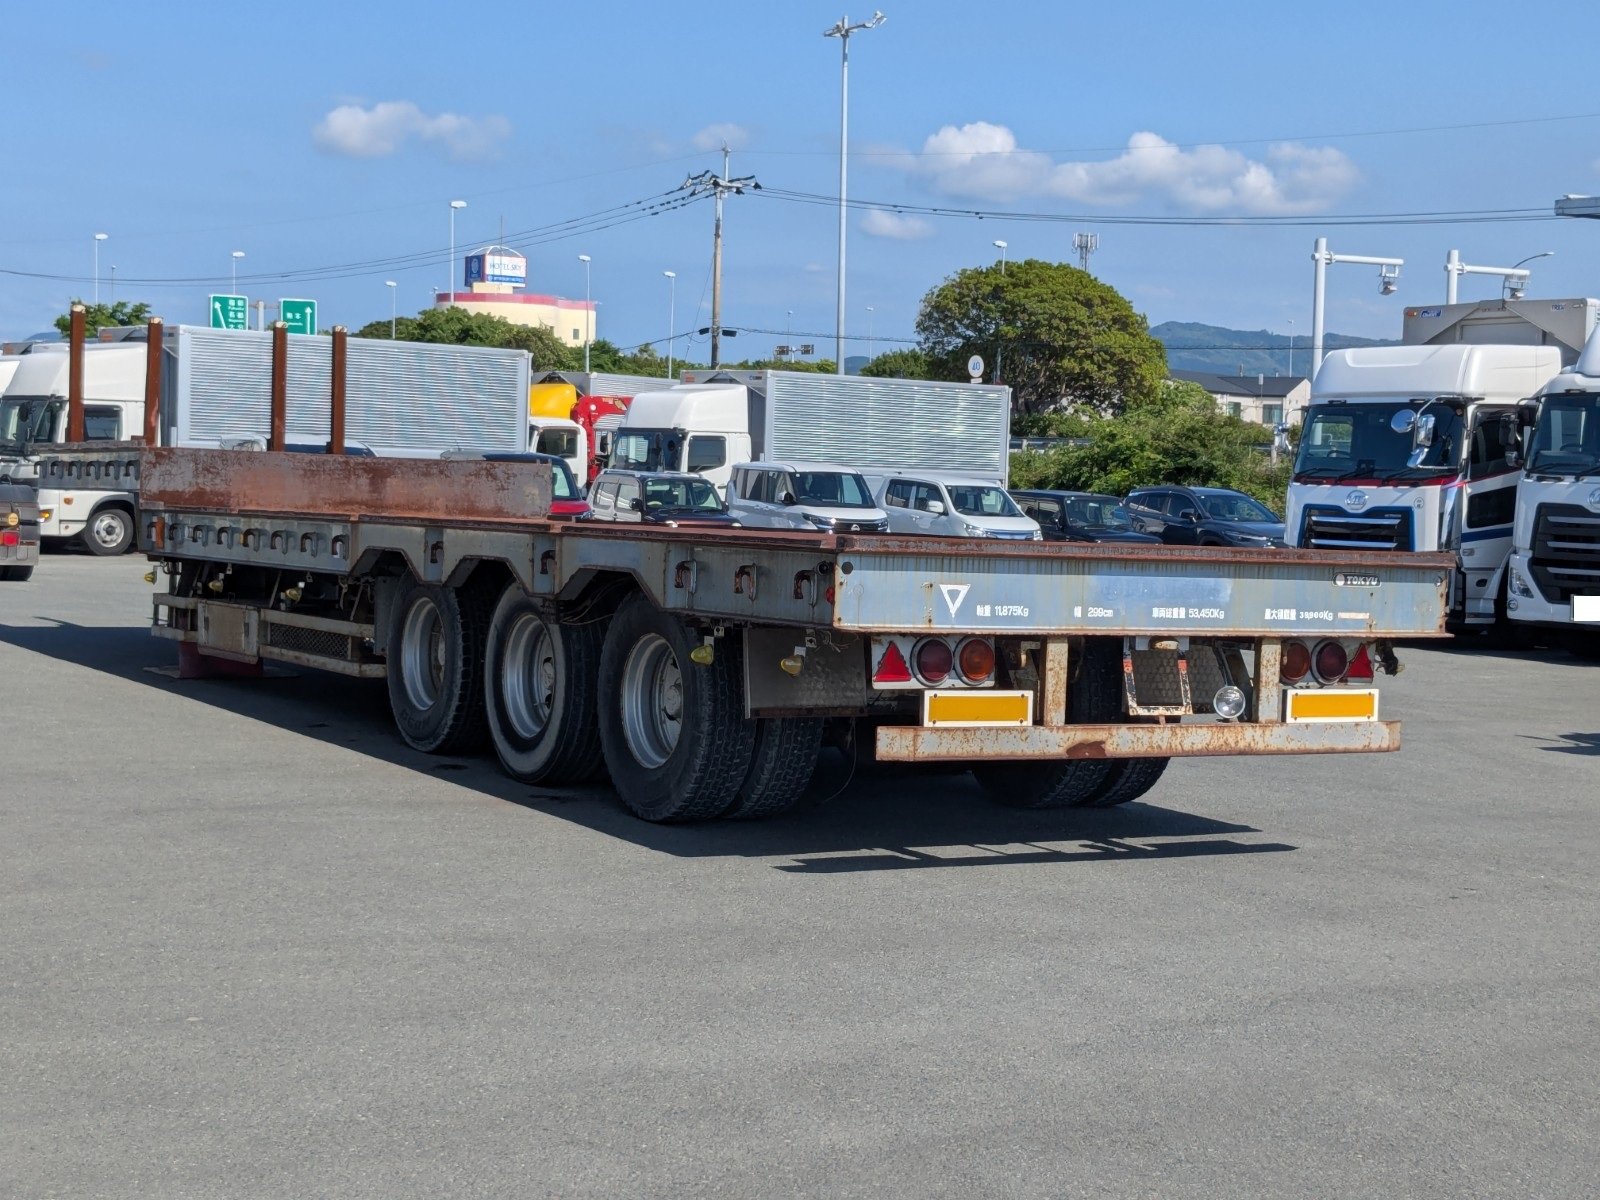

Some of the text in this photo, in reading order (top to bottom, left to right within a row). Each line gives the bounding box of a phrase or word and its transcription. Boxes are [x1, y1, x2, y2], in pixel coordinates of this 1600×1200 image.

[971, 361, 981, 371] 40
[1346, 576, 1378, 585] TOKYU
[1088, 607, 1113, 618] 299cm
[1188, 608, 1225, 619] 53,450Kg
